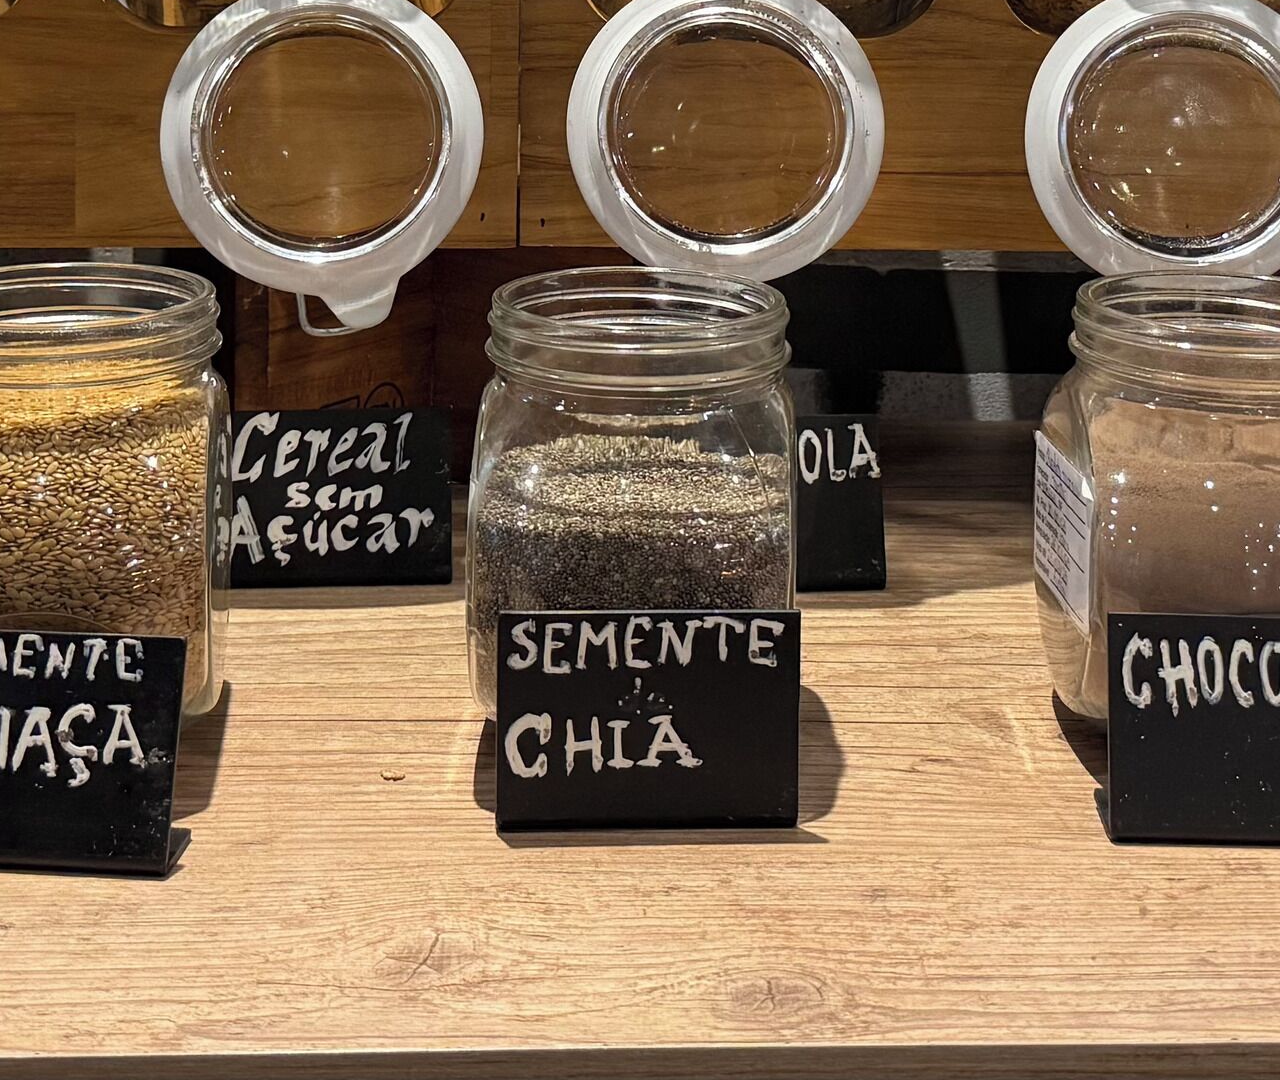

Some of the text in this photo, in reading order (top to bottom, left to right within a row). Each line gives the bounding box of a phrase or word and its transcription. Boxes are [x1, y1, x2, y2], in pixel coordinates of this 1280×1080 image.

[230, 411, 414, 483] Cereal
[284, 481, 384, 512] sem
[230, 495, 435, 567] Açúcar
[506, 615, 785, 674] SEMENTE
